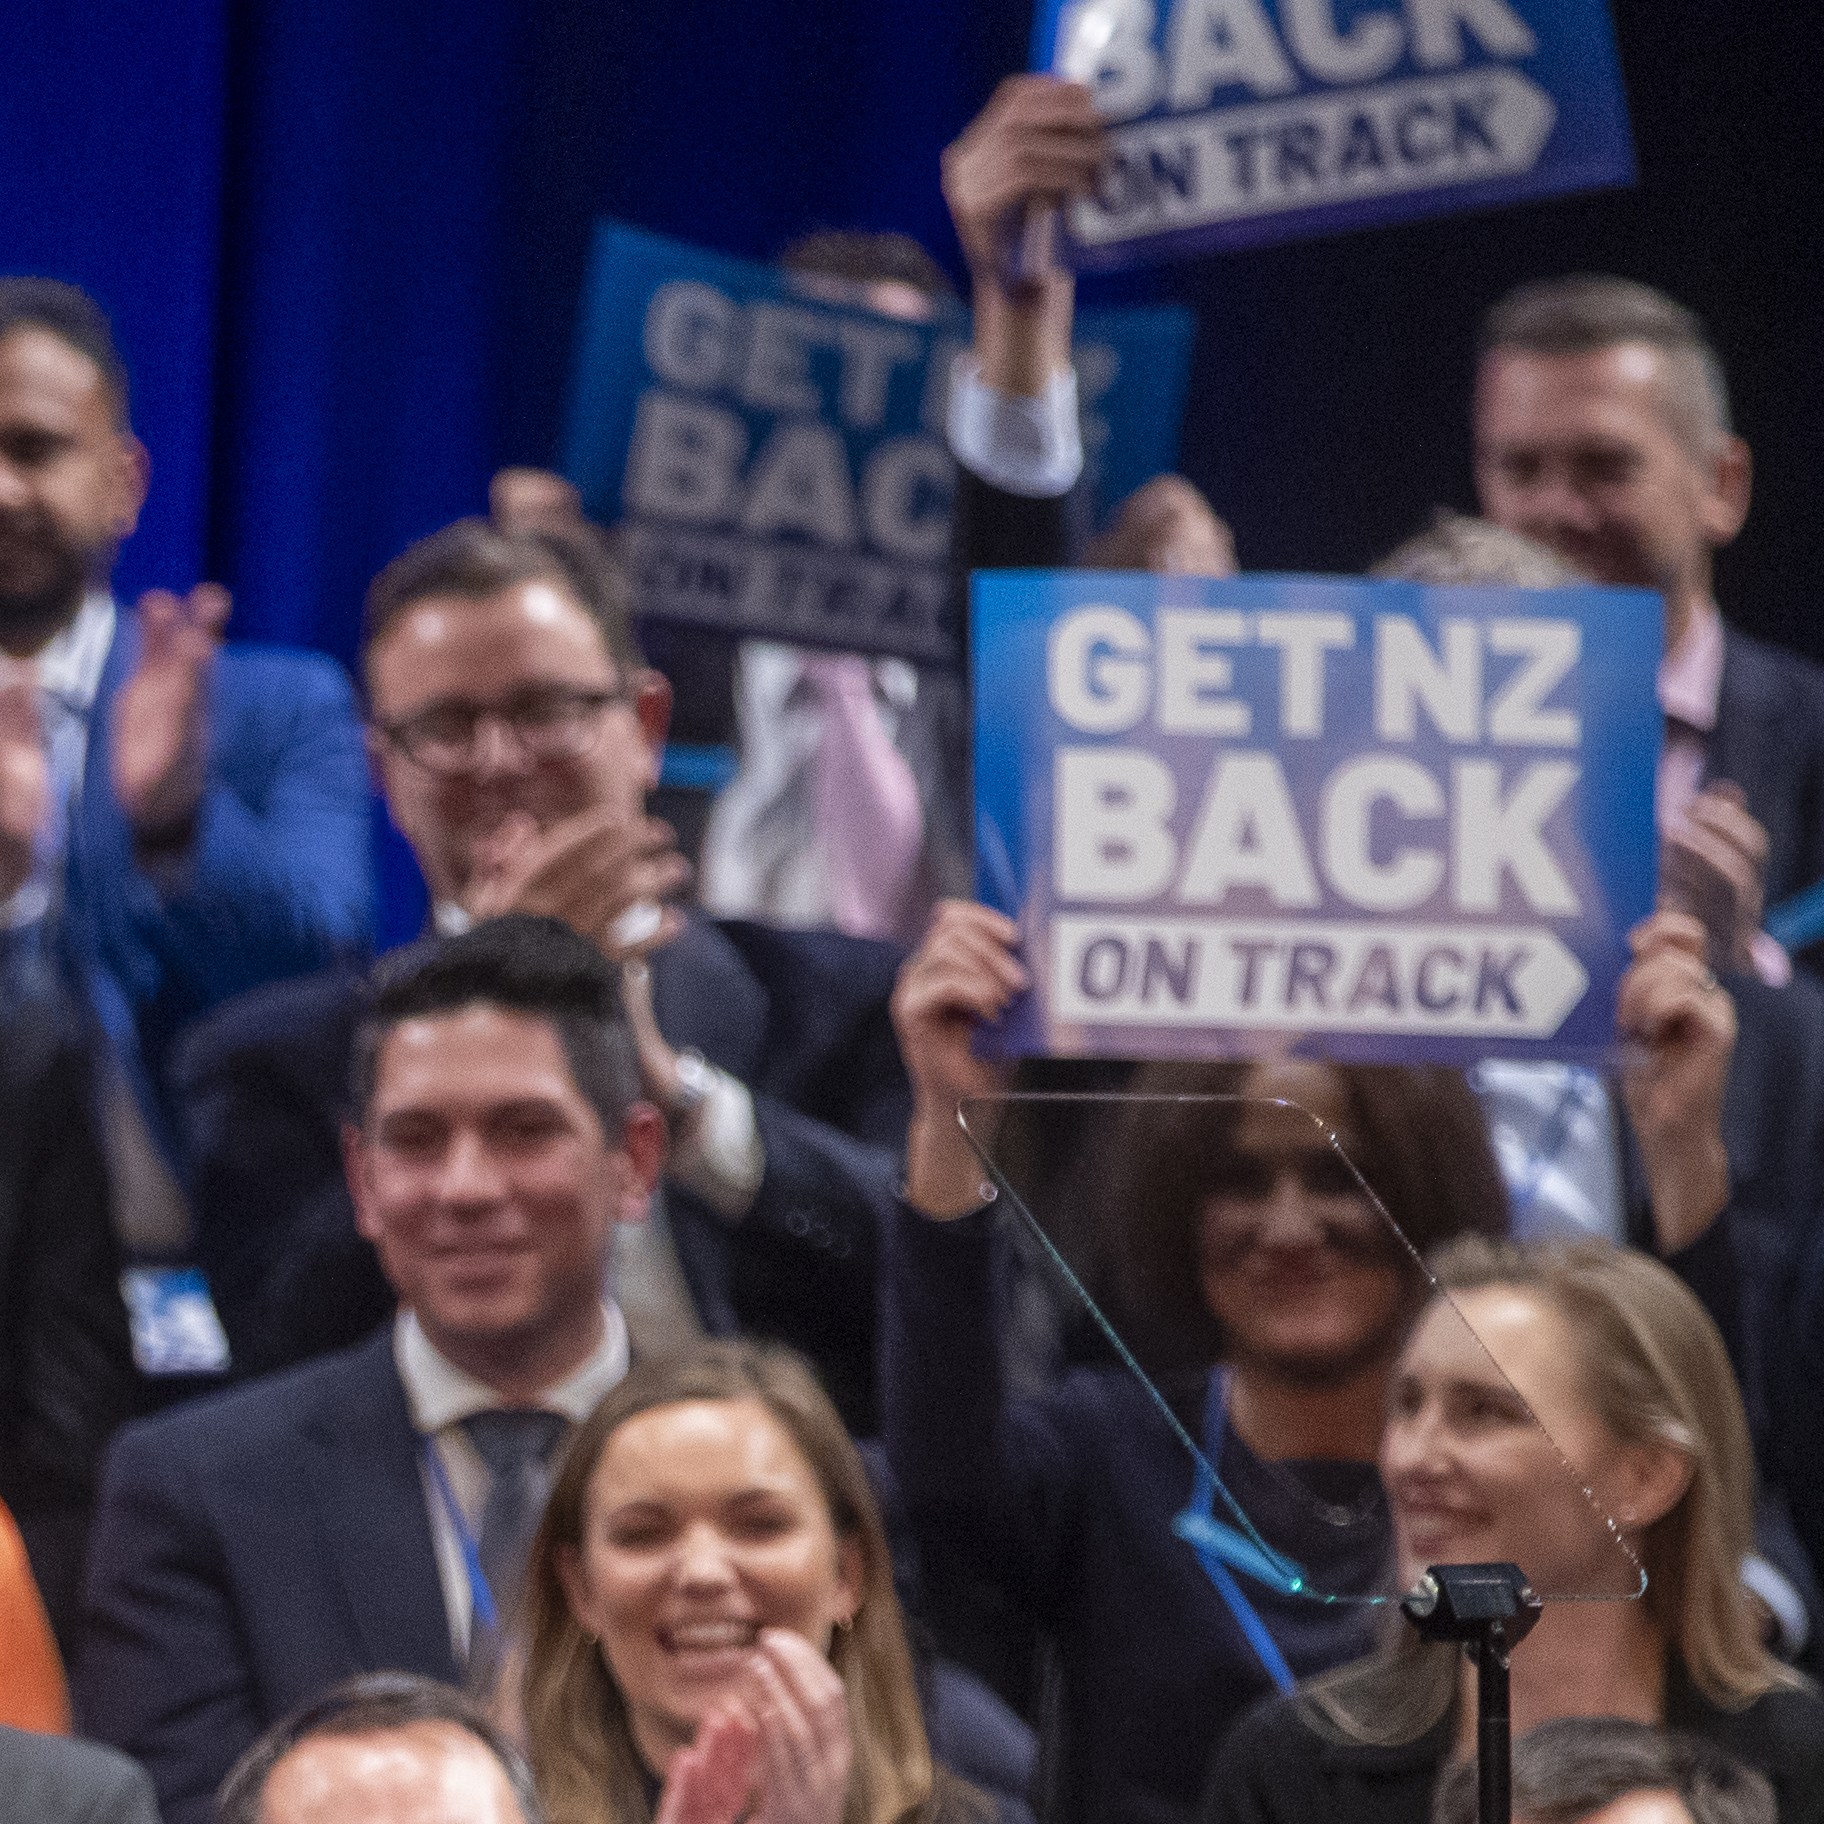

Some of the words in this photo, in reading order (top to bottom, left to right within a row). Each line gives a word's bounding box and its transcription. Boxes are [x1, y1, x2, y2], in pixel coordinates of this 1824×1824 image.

[1225, 99, 1498, 188] TRACK
[641, 278, 926, 428] GET
[625, 387, 955, 558] BAC
[1047, 604, 1355, 739] GET
[1375, 614, 1584, 749] NZ
[1056, 748, 1583, 918] BACK
[1076, 934, 1199, 1009] ON
[1228, 937, 1539, 1022] TRACK
